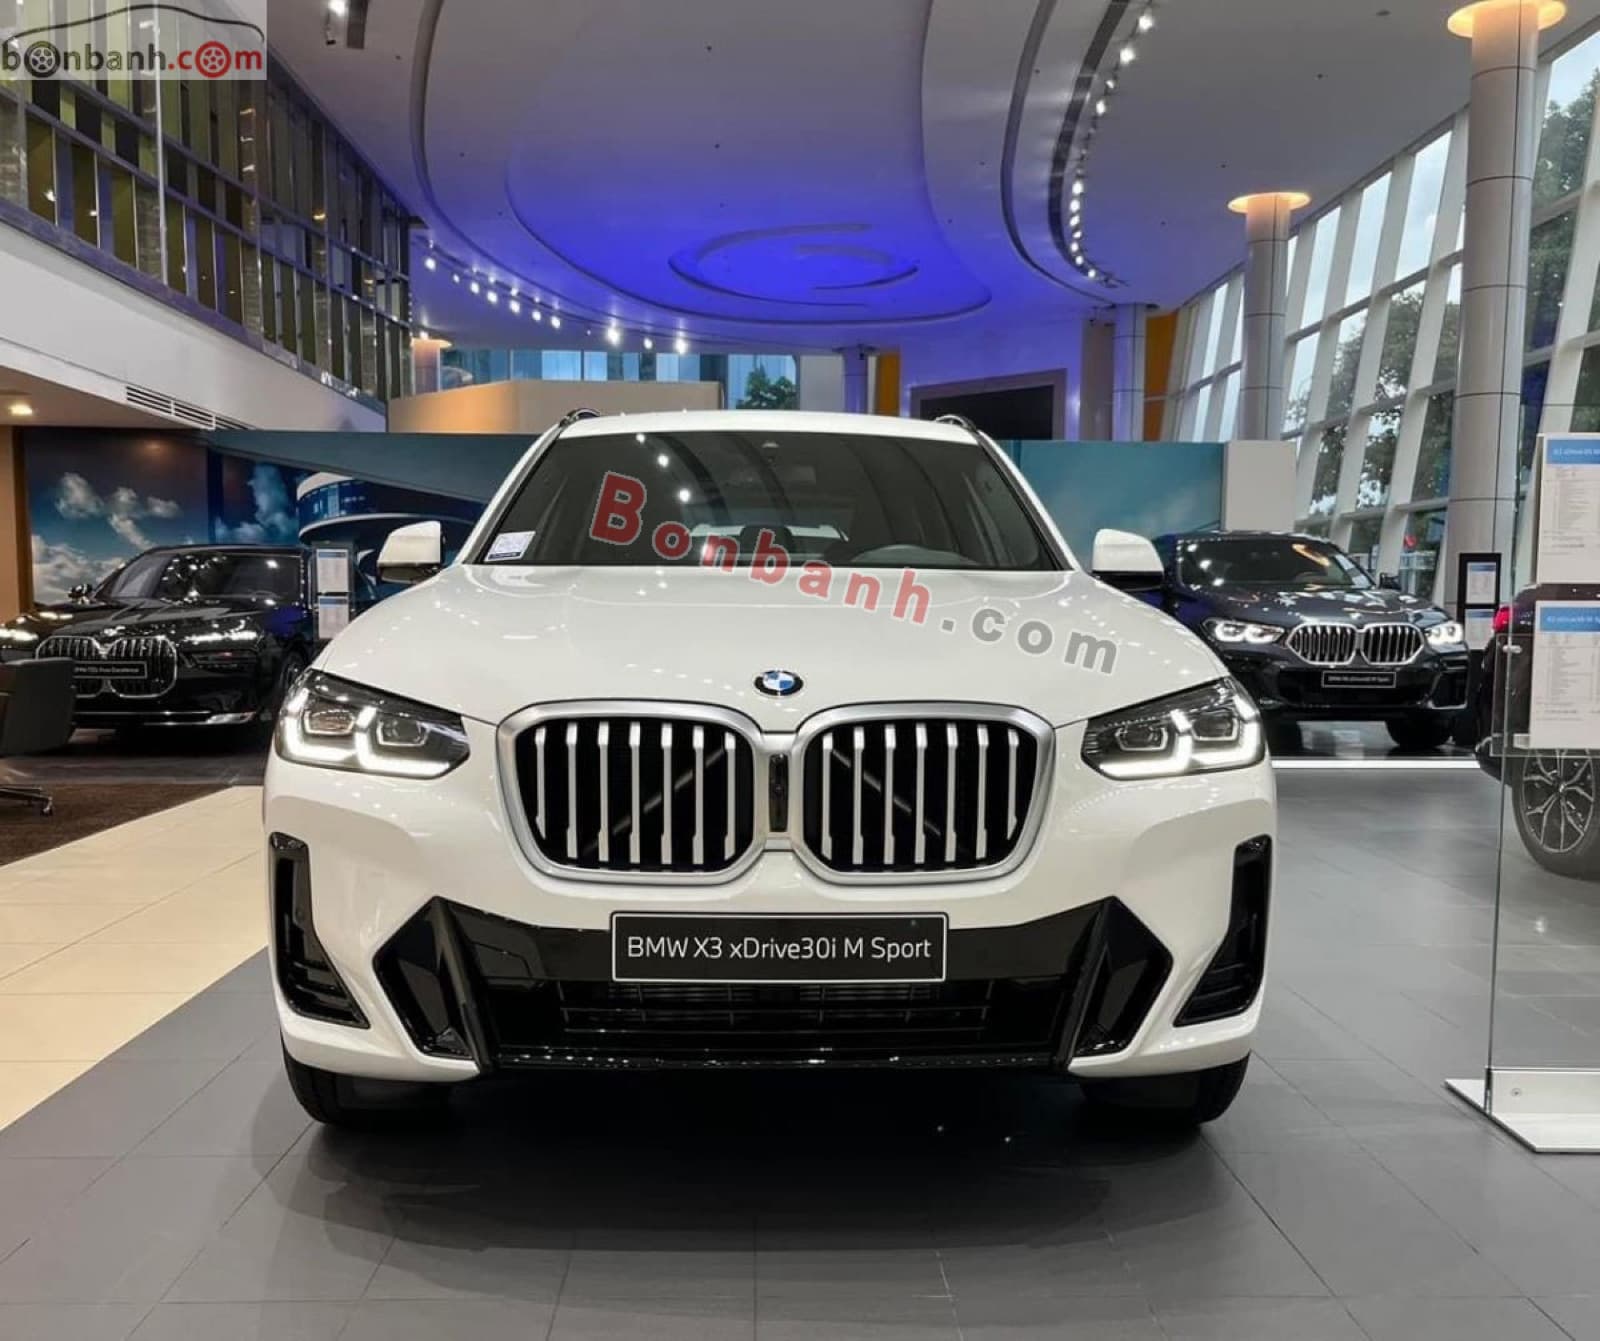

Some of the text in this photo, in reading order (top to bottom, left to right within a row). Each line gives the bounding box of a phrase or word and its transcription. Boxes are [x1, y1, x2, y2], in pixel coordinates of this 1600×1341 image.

[627, 936, 932, 963] BMW X3 xDrive30i M Sport
